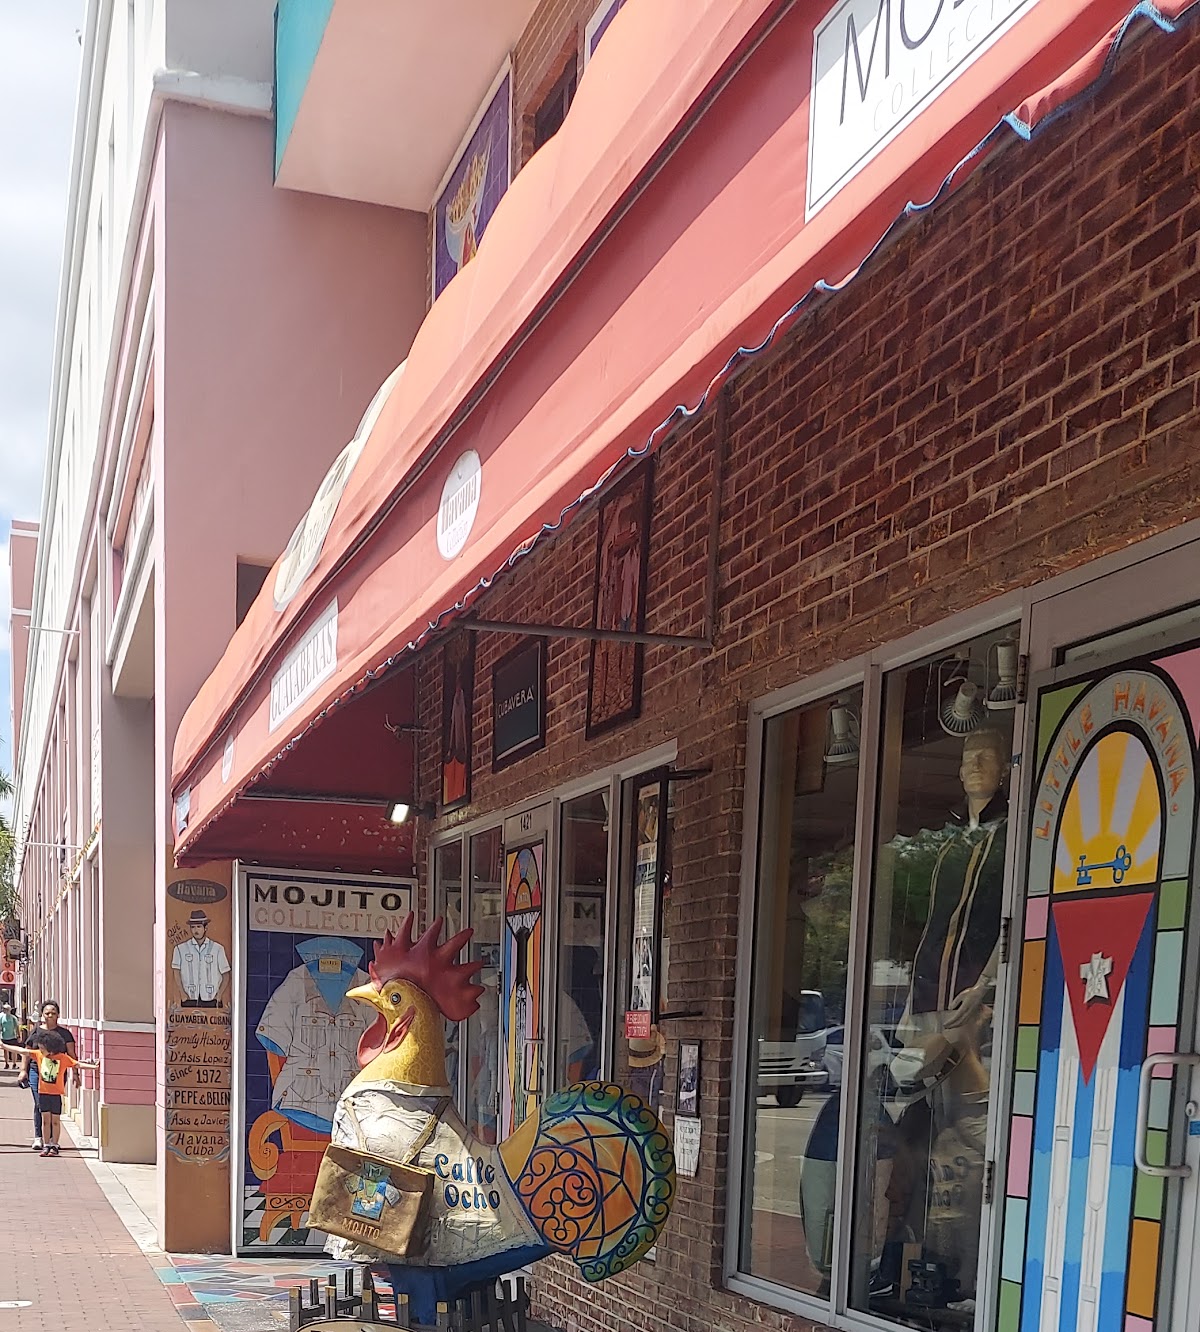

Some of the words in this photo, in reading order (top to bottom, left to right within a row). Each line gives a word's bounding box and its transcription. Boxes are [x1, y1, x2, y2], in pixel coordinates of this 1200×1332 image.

[1035, 703, 1094, 841] LITTLE
[519, 813, 533, 832] 1421
[176, 883, 217, 897] Havana
[253, 883, 403, 911] MOJITO
[254, 907, 405, 934] COLLECTION
[166, 1030, 200, 1049] Family
[199, 1032, 231, 1051] History
[196, 1069, 222, 1084] 1972
[174, 1090, 198, 1105] PEPE
[206, 1091, 230, 1106] BELEN
[170, 1112, 191, 1126] Asis
[200, 1114, 228, 1126] Javier
[175, 1132, 225, 1146] Havana
[185, 1145, 215, 1156] Cuba
[434, 1153, 496, 1185] Calle
[443, 1183, 501, 1210] Ocho
[341, 1217, 380, 1240] MOJITO
